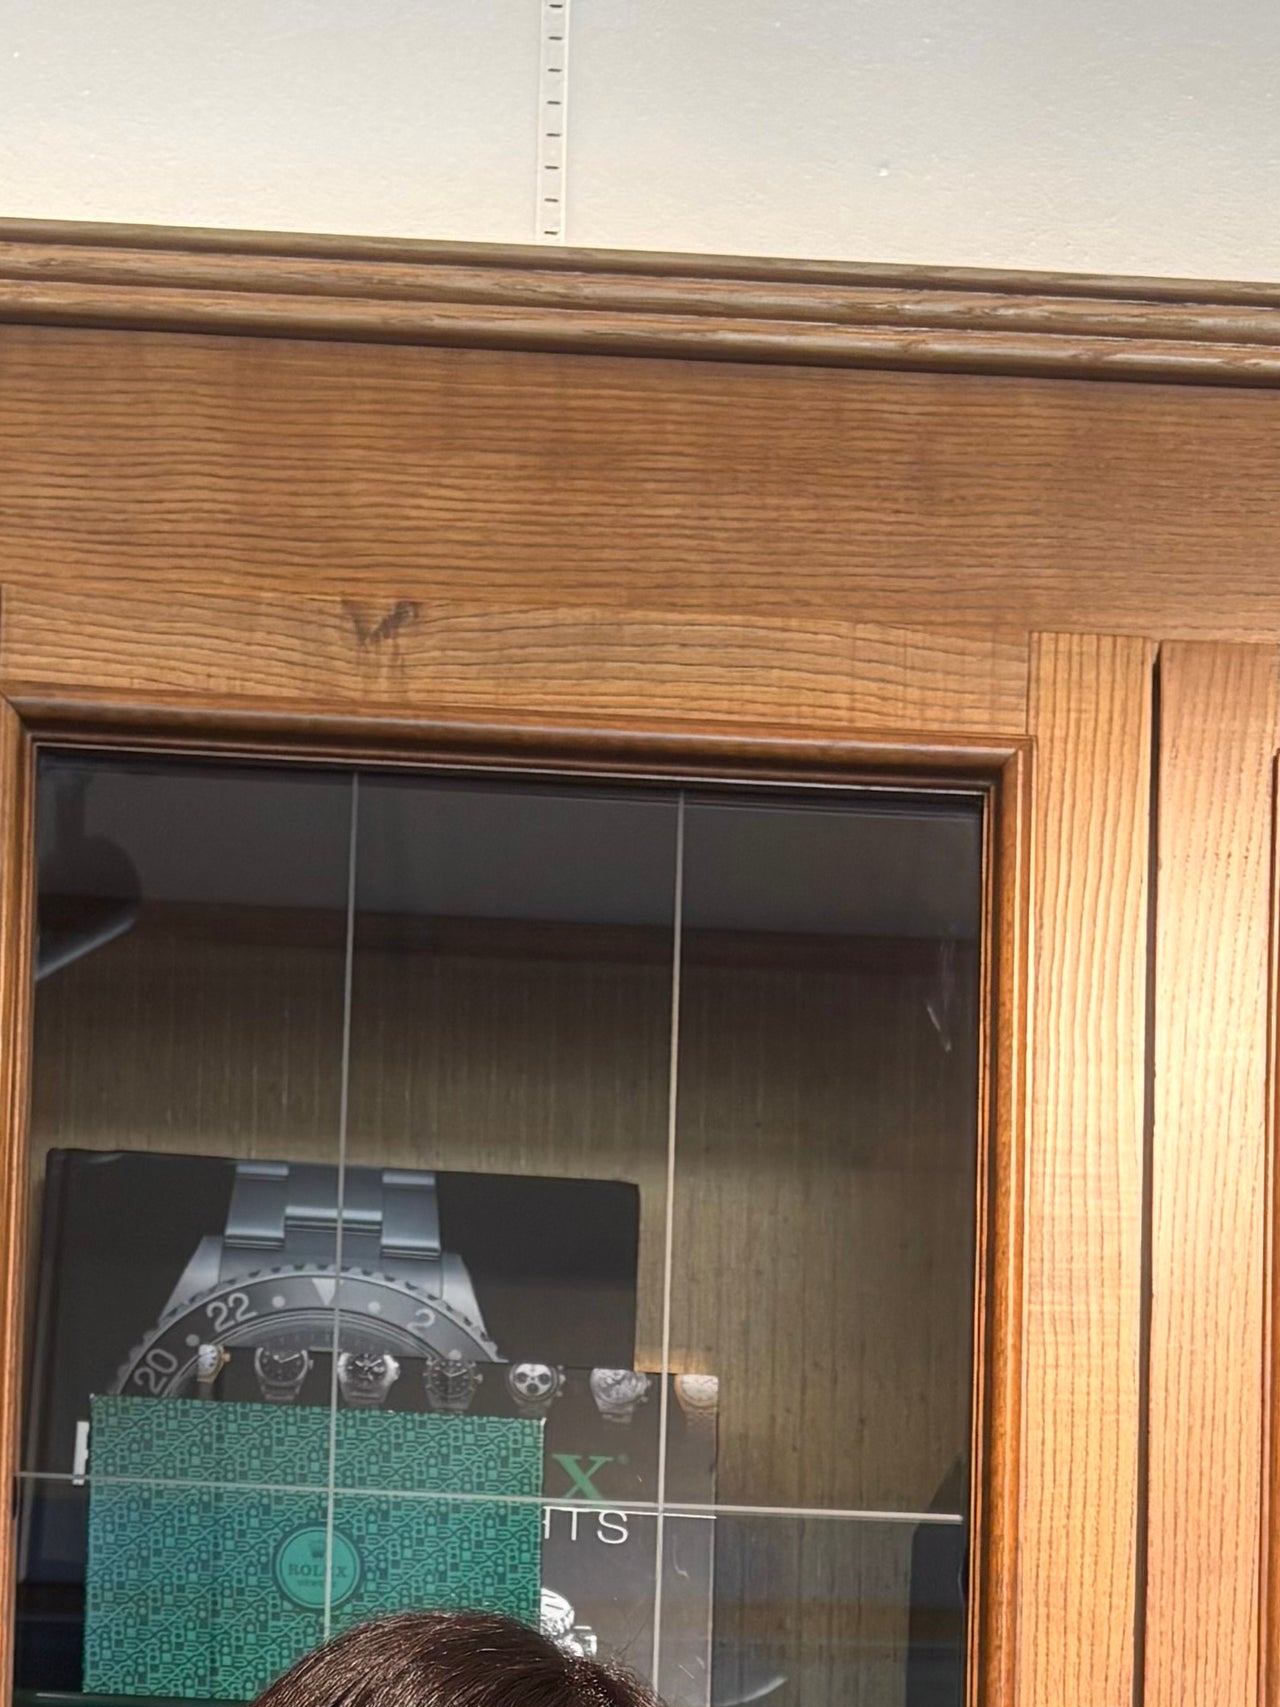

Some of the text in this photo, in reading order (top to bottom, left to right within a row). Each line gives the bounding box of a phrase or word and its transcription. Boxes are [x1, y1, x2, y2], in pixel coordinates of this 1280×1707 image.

[206, 1292, 258, 1333] 22
[407, 1308, 436, 1333] 2
[134, 1348, 178, 1394] 20
[288, 1564, 348, 1578] ROLX
